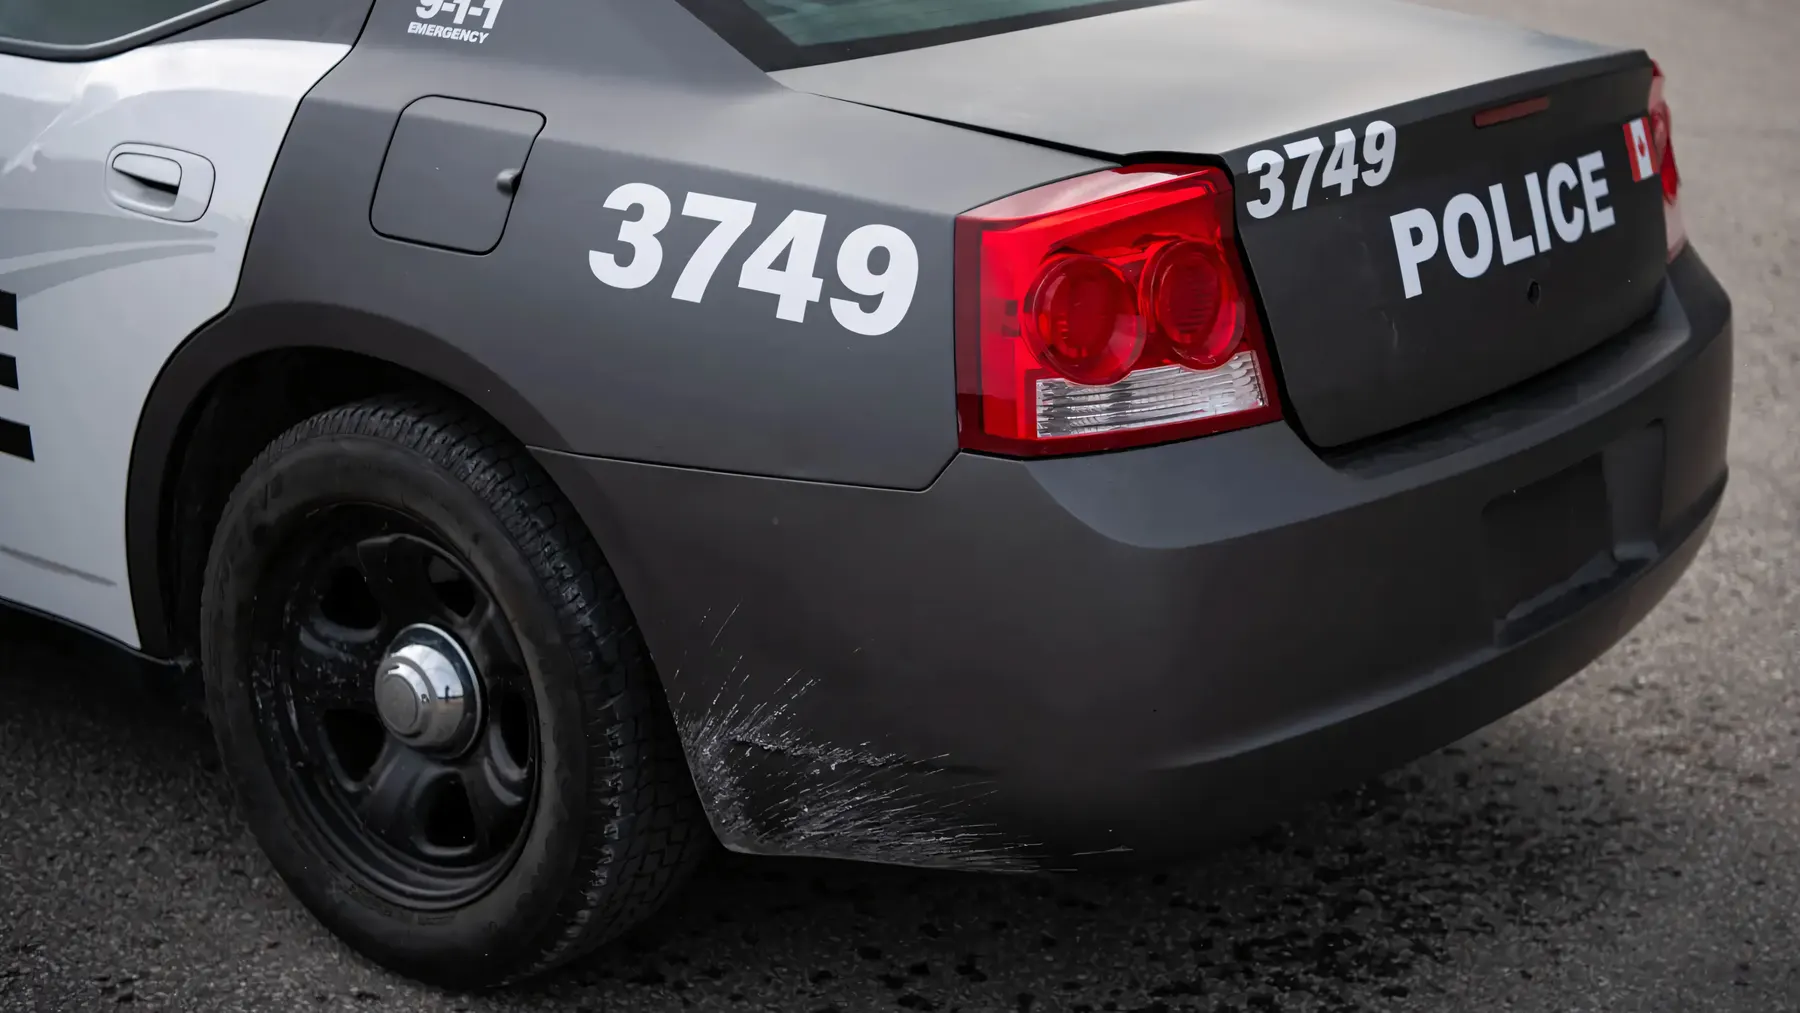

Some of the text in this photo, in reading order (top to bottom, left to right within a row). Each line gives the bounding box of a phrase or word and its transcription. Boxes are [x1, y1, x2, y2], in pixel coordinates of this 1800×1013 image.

[408, 22, 489, 43] EMERGENCY
[416, 0, 503, 29] 9-1-1
[1246, 120, 1397, 219] 3749
[589, 183, 919, 336] 3749
[1390, 151, 1616, 299] POLICE
